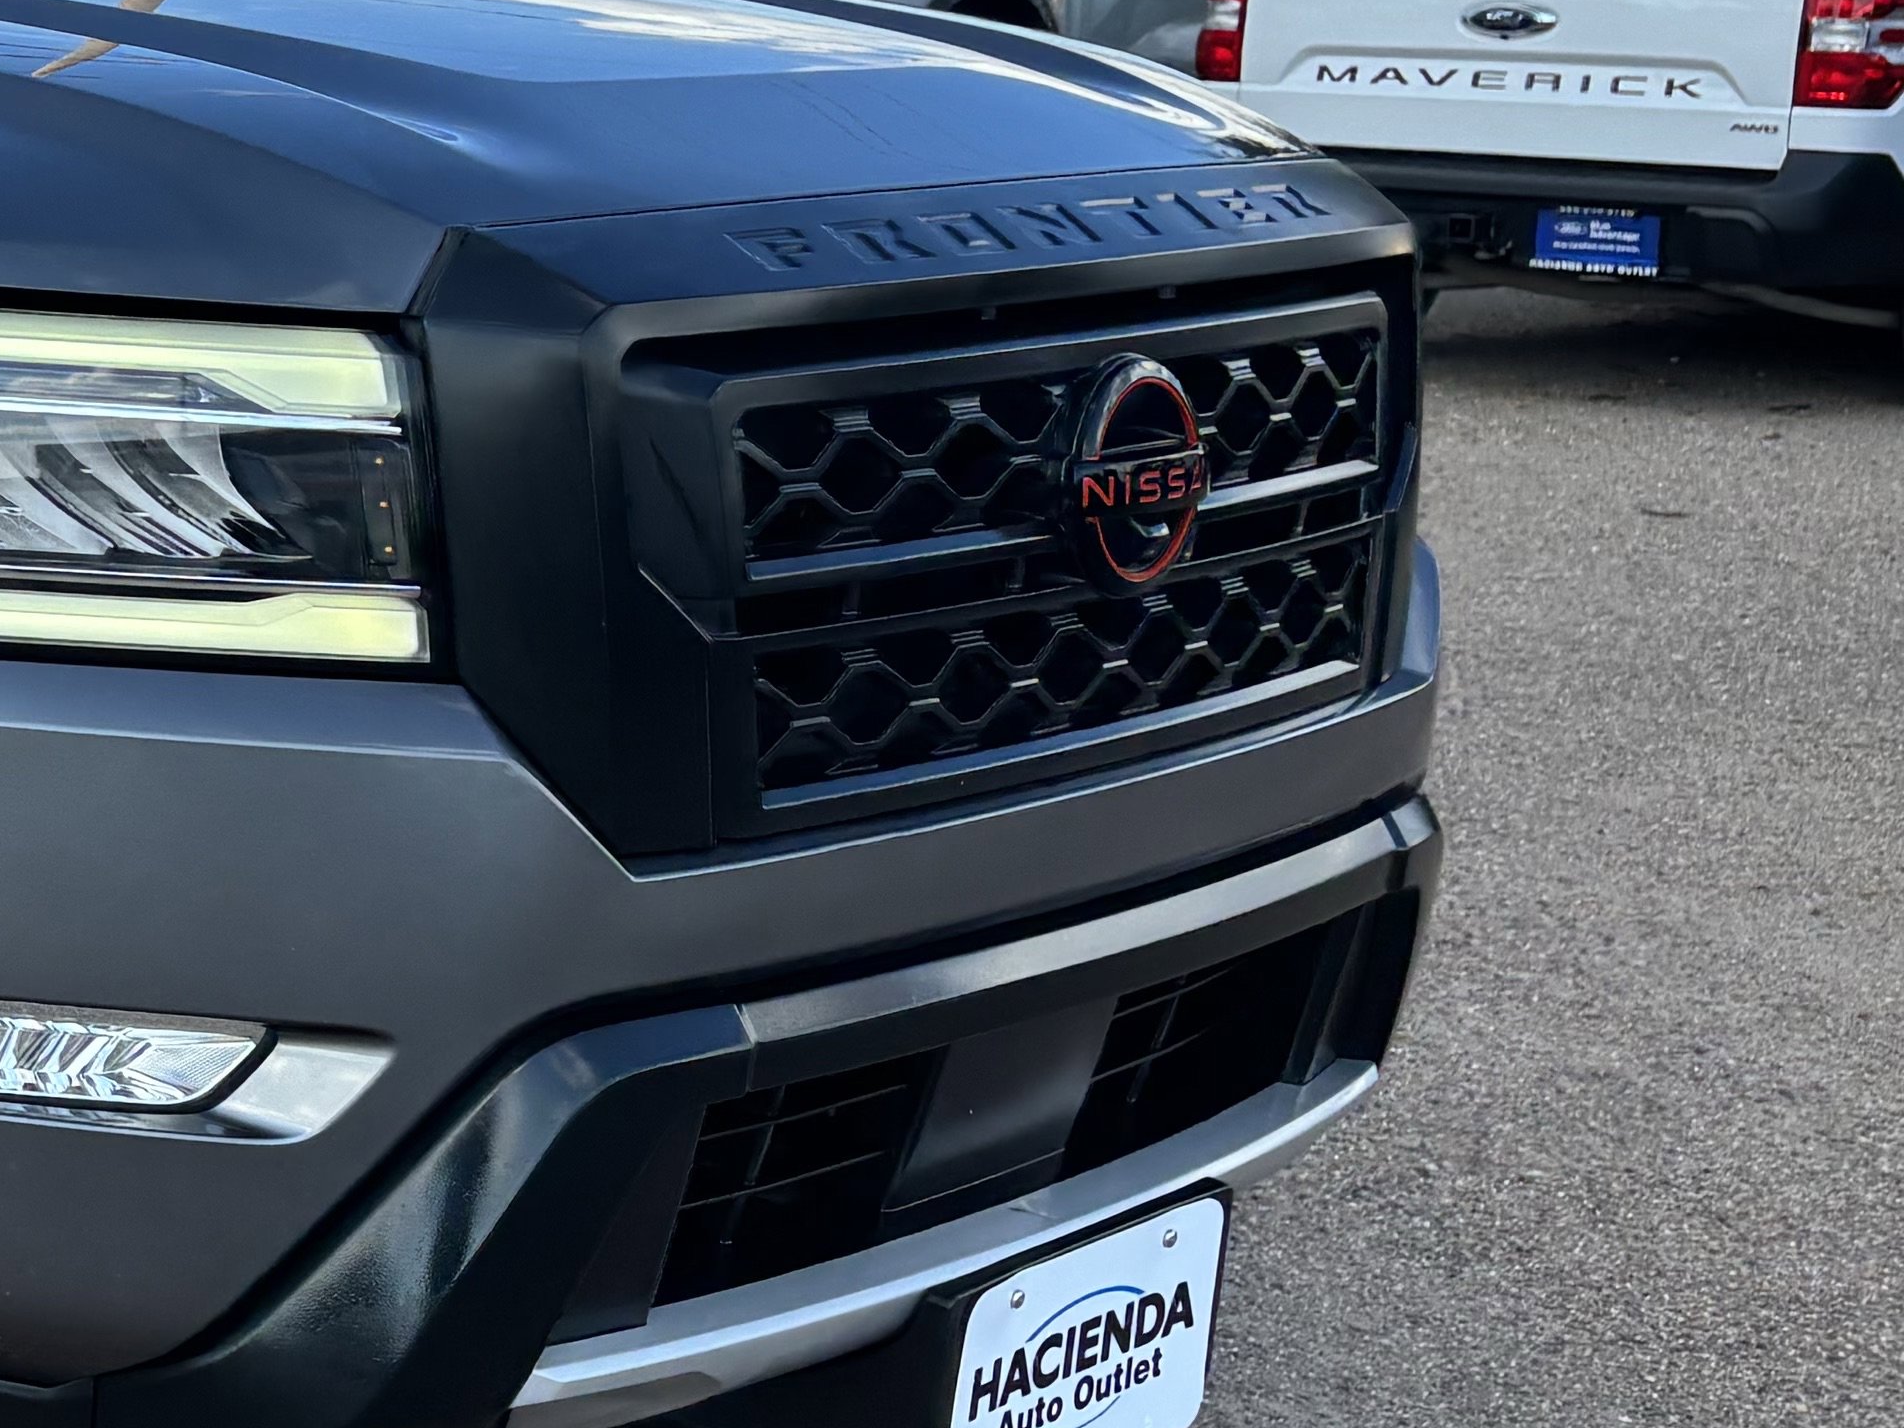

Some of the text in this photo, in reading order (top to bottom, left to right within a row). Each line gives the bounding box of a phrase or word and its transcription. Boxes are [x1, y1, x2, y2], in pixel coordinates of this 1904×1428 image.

[1316, 64, 1702, 99] MAVERICK
[723, 183, 1332, 272] FRONTIER
[968, 1281, 1194, 1422] HACIENDA
[1074, 1347, 1162, 1410] Outlet
